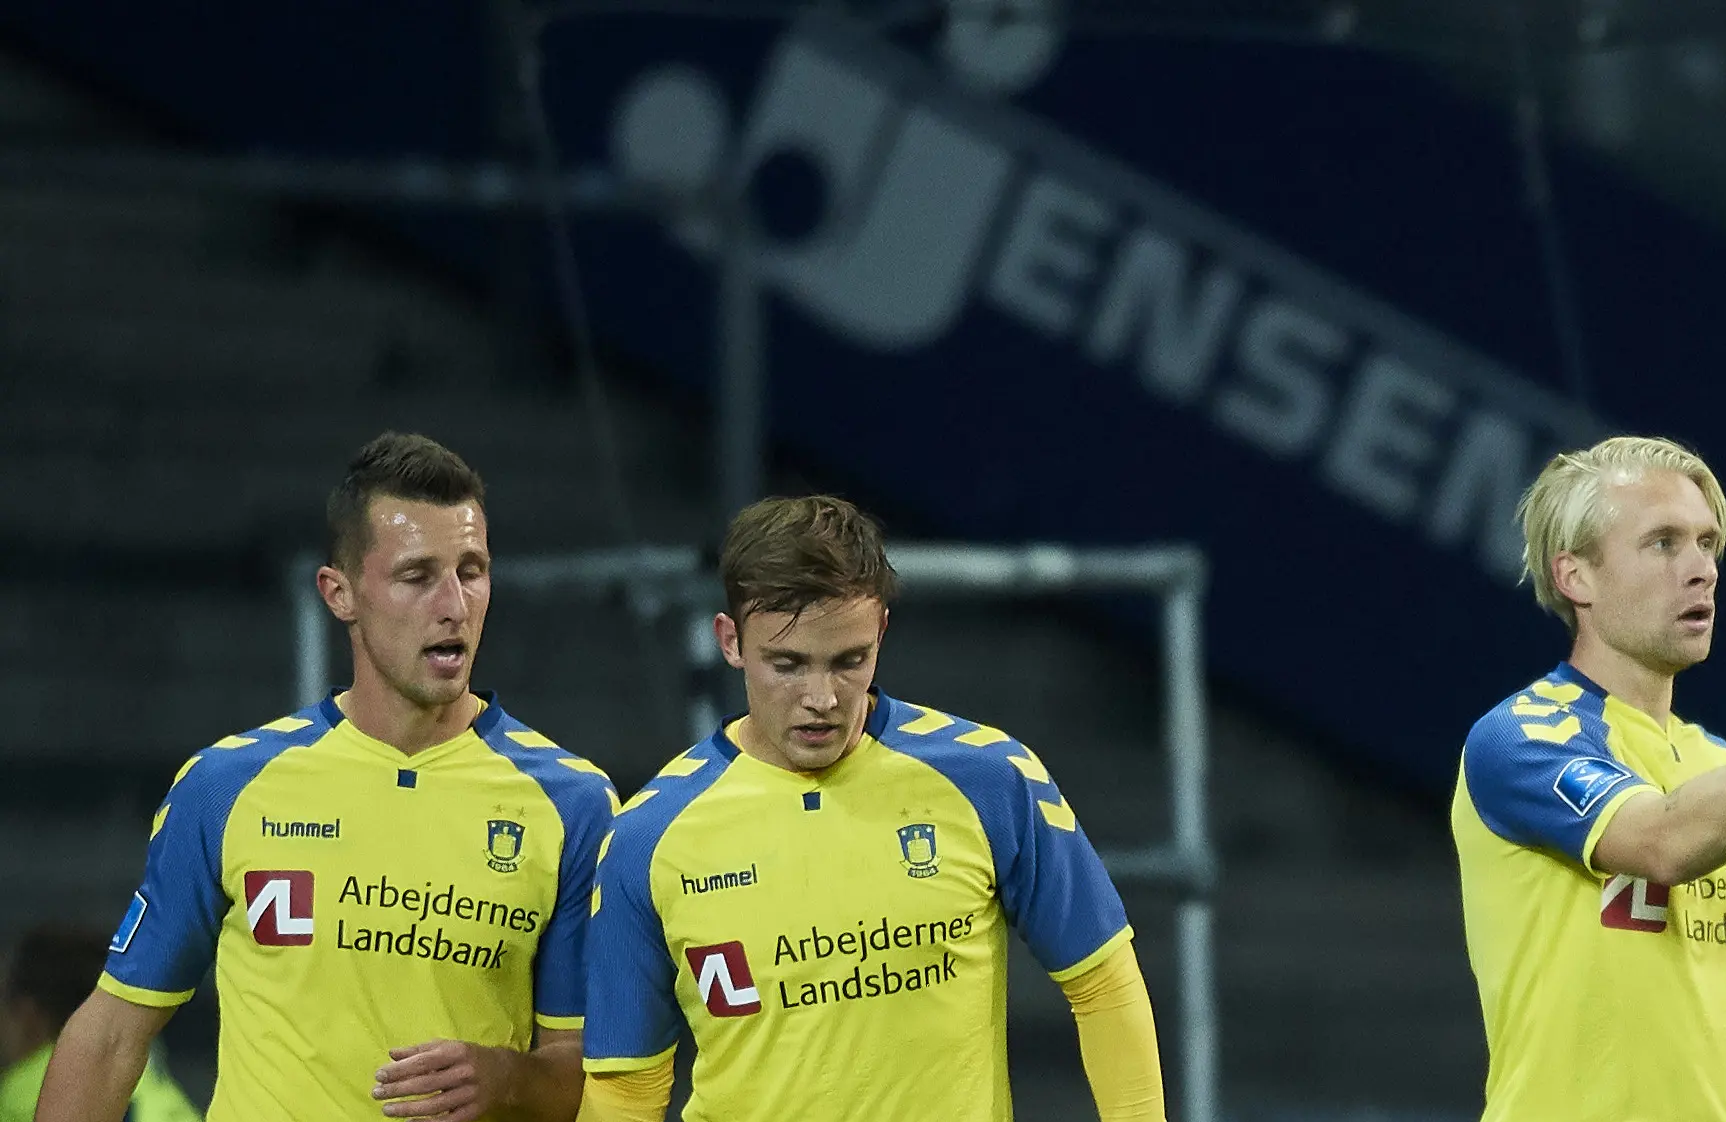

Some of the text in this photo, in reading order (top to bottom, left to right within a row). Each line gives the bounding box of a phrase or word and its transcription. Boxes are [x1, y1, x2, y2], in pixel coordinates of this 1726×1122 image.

[262, 815, 341, 839] hummel
[338, 874, 541, 934] Arbejdernes
[680, 863, 759, 896] hummel
[336, 918, 509, 970] Landsbank
[773, 913, 975, 966] Arbejdernes
[778, 951, 958, 1009] Landsbank
